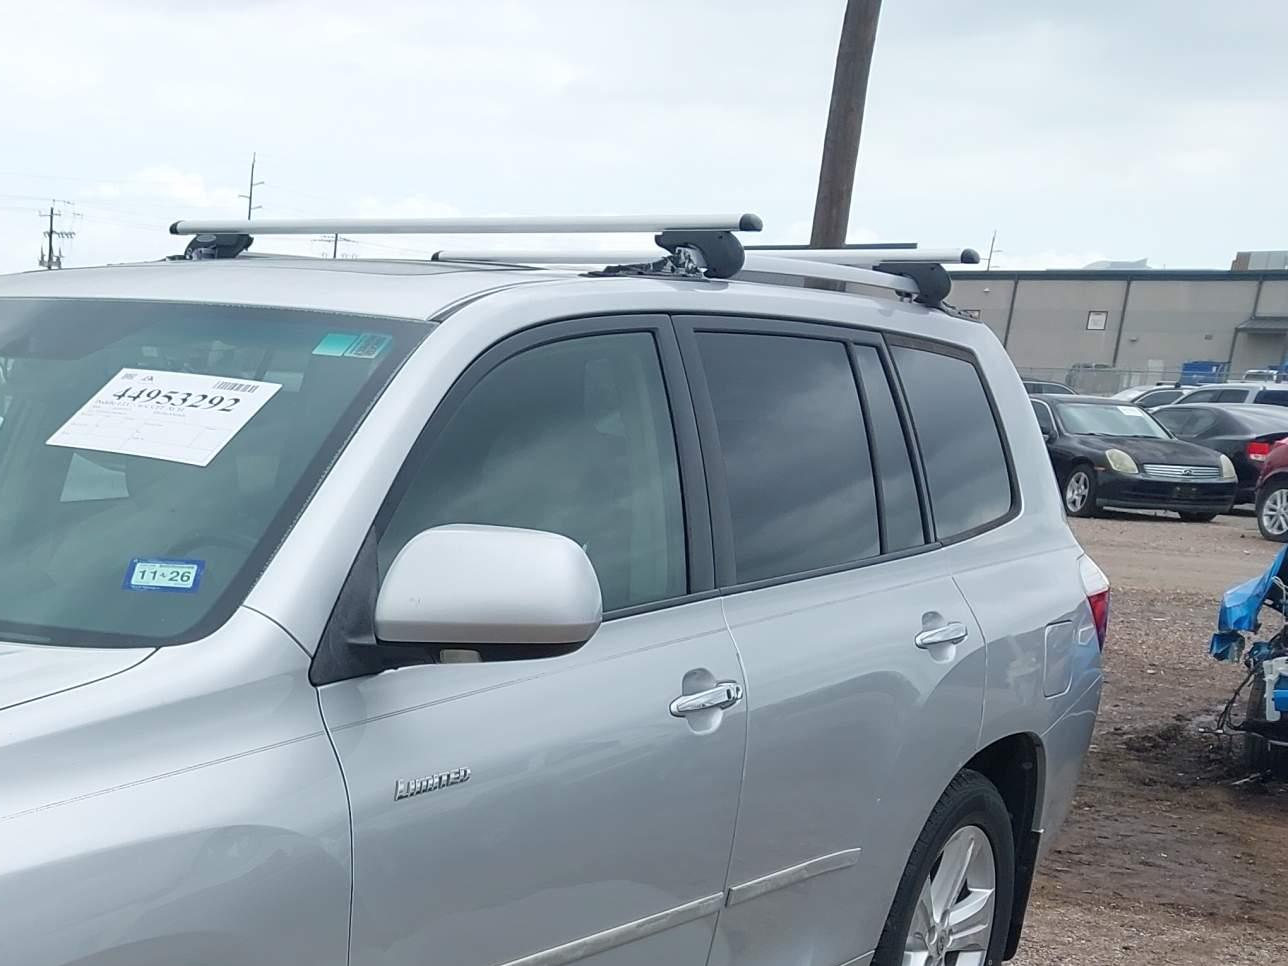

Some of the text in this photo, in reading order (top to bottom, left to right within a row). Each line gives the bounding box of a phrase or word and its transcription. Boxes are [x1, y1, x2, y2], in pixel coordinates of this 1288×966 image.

[113, 386, 241, 413] 44953292
[139, 569, 192, 583] 11 26
[394, 767, 471, 801] LIMITED
